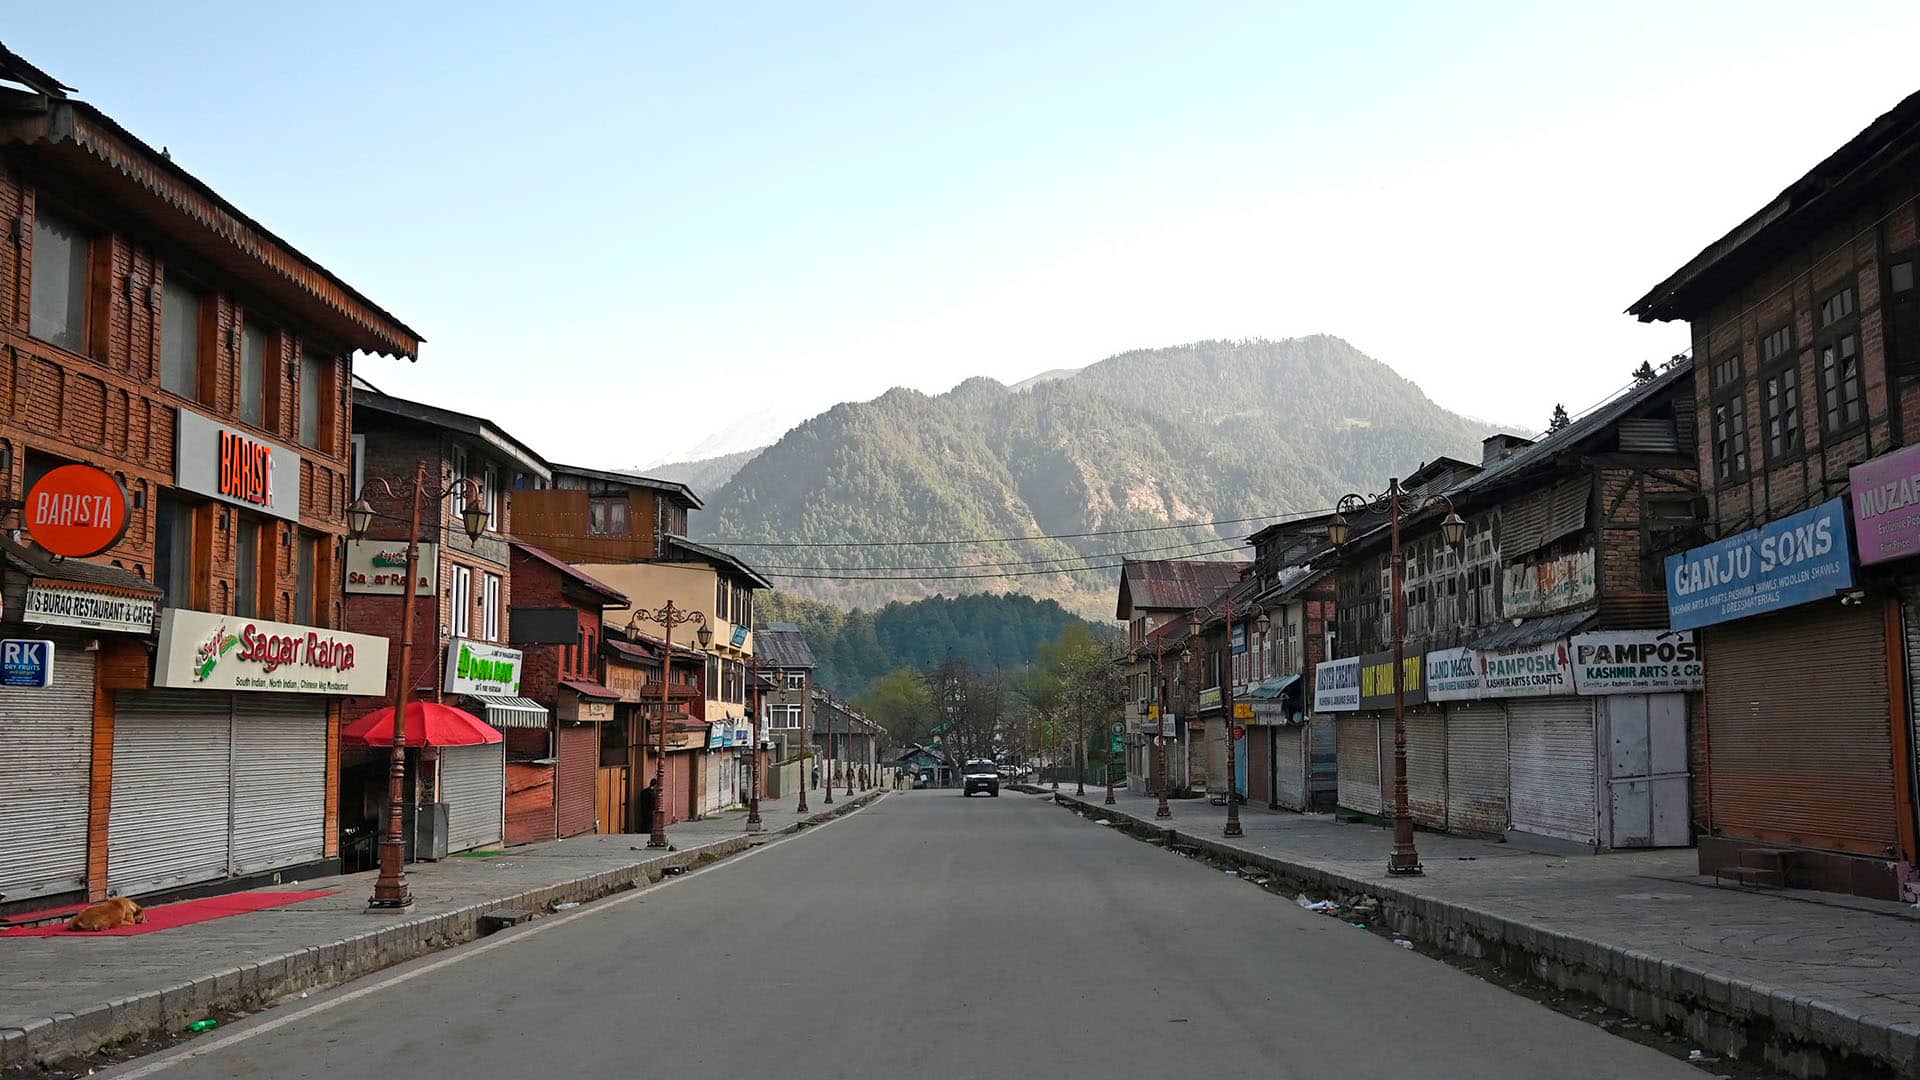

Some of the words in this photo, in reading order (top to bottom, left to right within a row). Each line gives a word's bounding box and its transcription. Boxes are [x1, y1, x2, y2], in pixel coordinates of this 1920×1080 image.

[36, 492, 111, 529] BARISTA
[1675, 544, 1751, 597] GANJU
[1760, 516, 1833, 574] SONS
[349, 571, 389, 587] Saar
[391, 573, 428, 587] Raa
[1811, 561, 1840, 580] SHAWLS
[43, 593, 72, 616] BURAQ
[73, 597, 124, 620] RESTAURANT
[125, 604, 131, 621] &
[132, 605, 152, 624] CAFE
[5, 643, 40, 664] RK
[239, 623, 303, 672] Sagar
[305, 632, 354, 672] Ratna
[1429, 660, 1449, 680] LAND
[1450, 657, 1475, 677] MARK
[1488, 653, 1557, 677] PAMPOSH
[1586, 666, 1637, 679] KASHMIR
[1639, 665, 1668, 678] ARTS
[1671, 665, 1681, 677] &
[235, 676, 250, 686] South
[269, 679, 282, 688] North
[300, 680, 318, 689] Chinese
[326, 681, 349, 690] Restaurant
[1486, 677, 1511, 689] KASHMIR
[1532, 673, 1563, 686] CRAFTS
